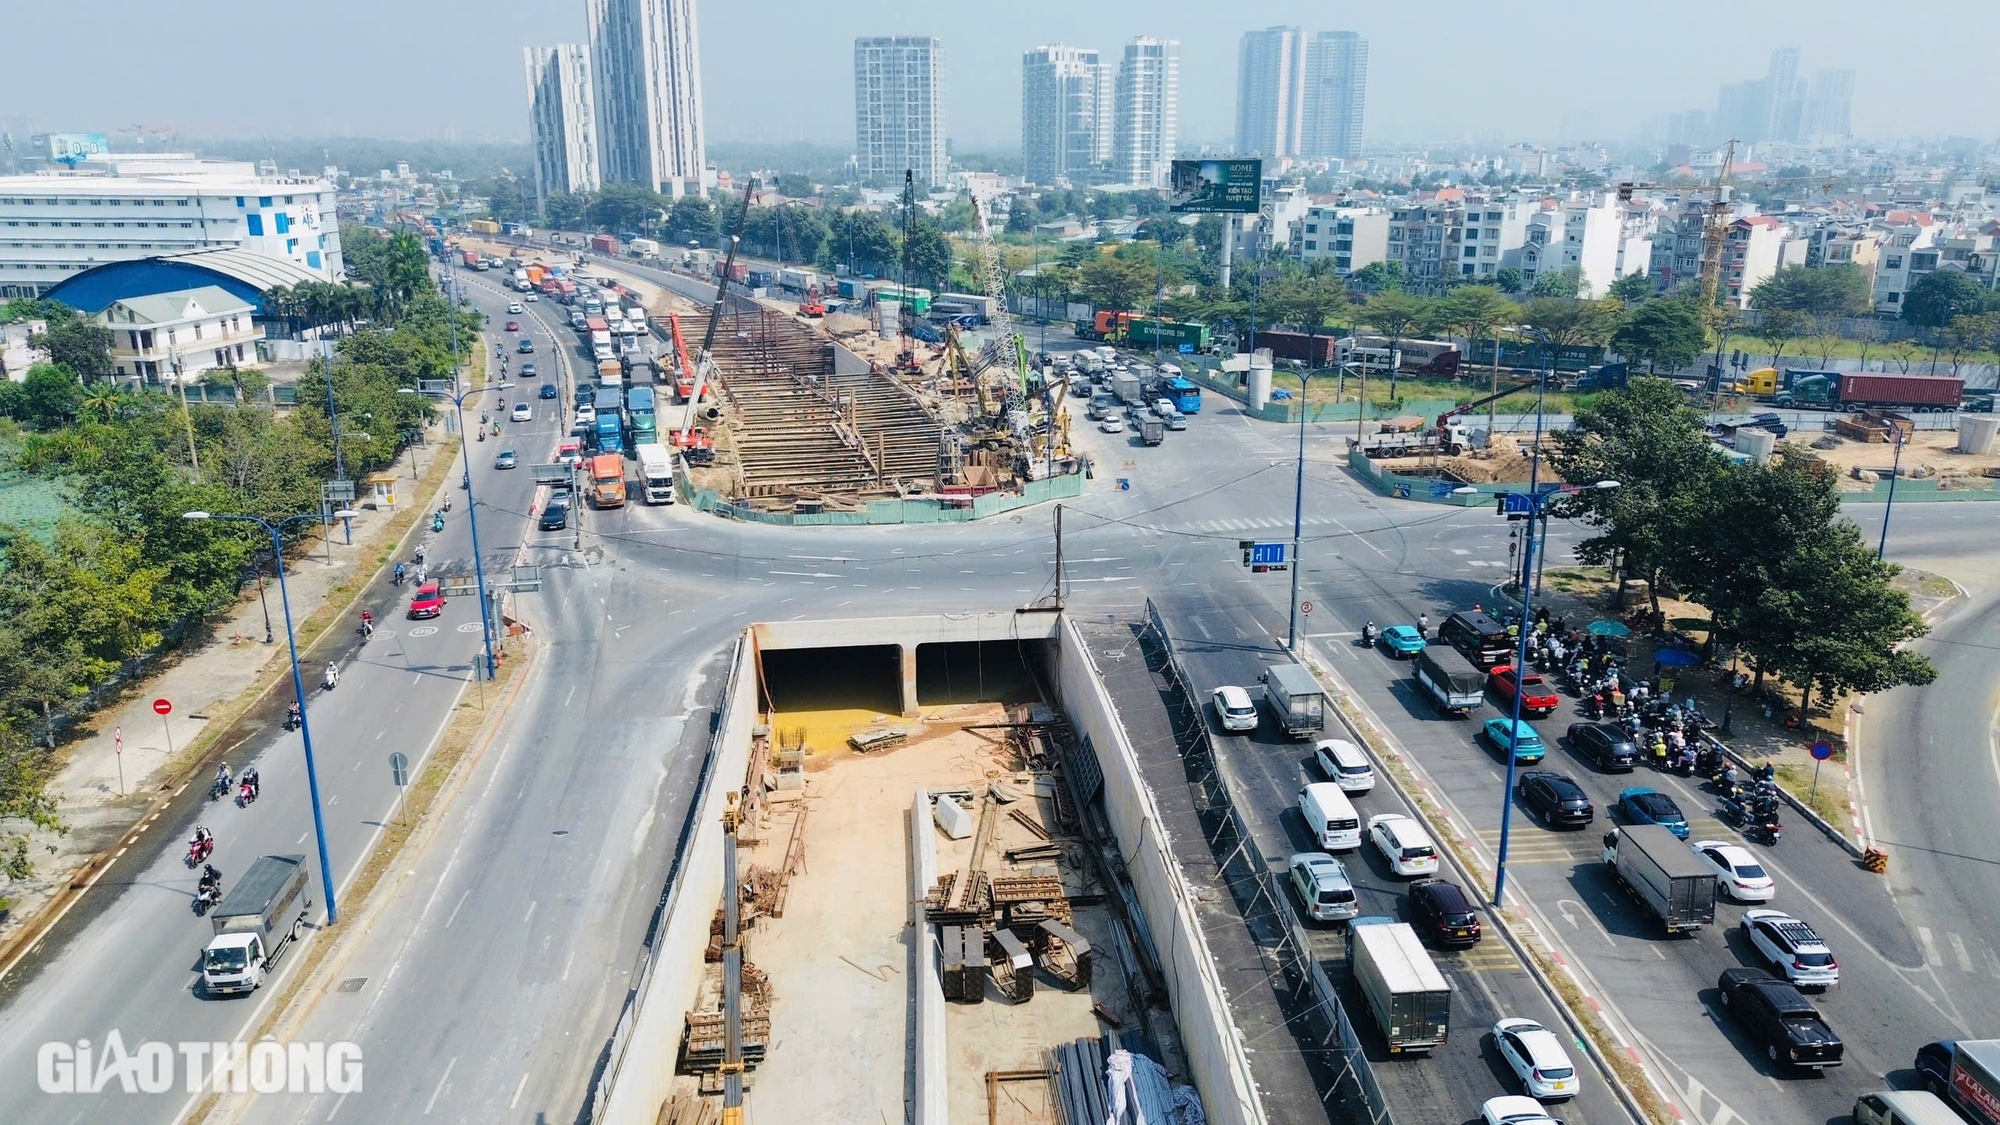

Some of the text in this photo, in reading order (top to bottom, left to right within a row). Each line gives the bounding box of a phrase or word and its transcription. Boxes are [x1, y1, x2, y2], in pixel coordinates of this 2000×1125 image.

[1229, 164, 1254, 172] ROME
[1243, 194, 1254, 202] TÁC
[1464, 196, 1485, 204] HOTEL
[1144, 327, 1185, 337] EVERGREEN
